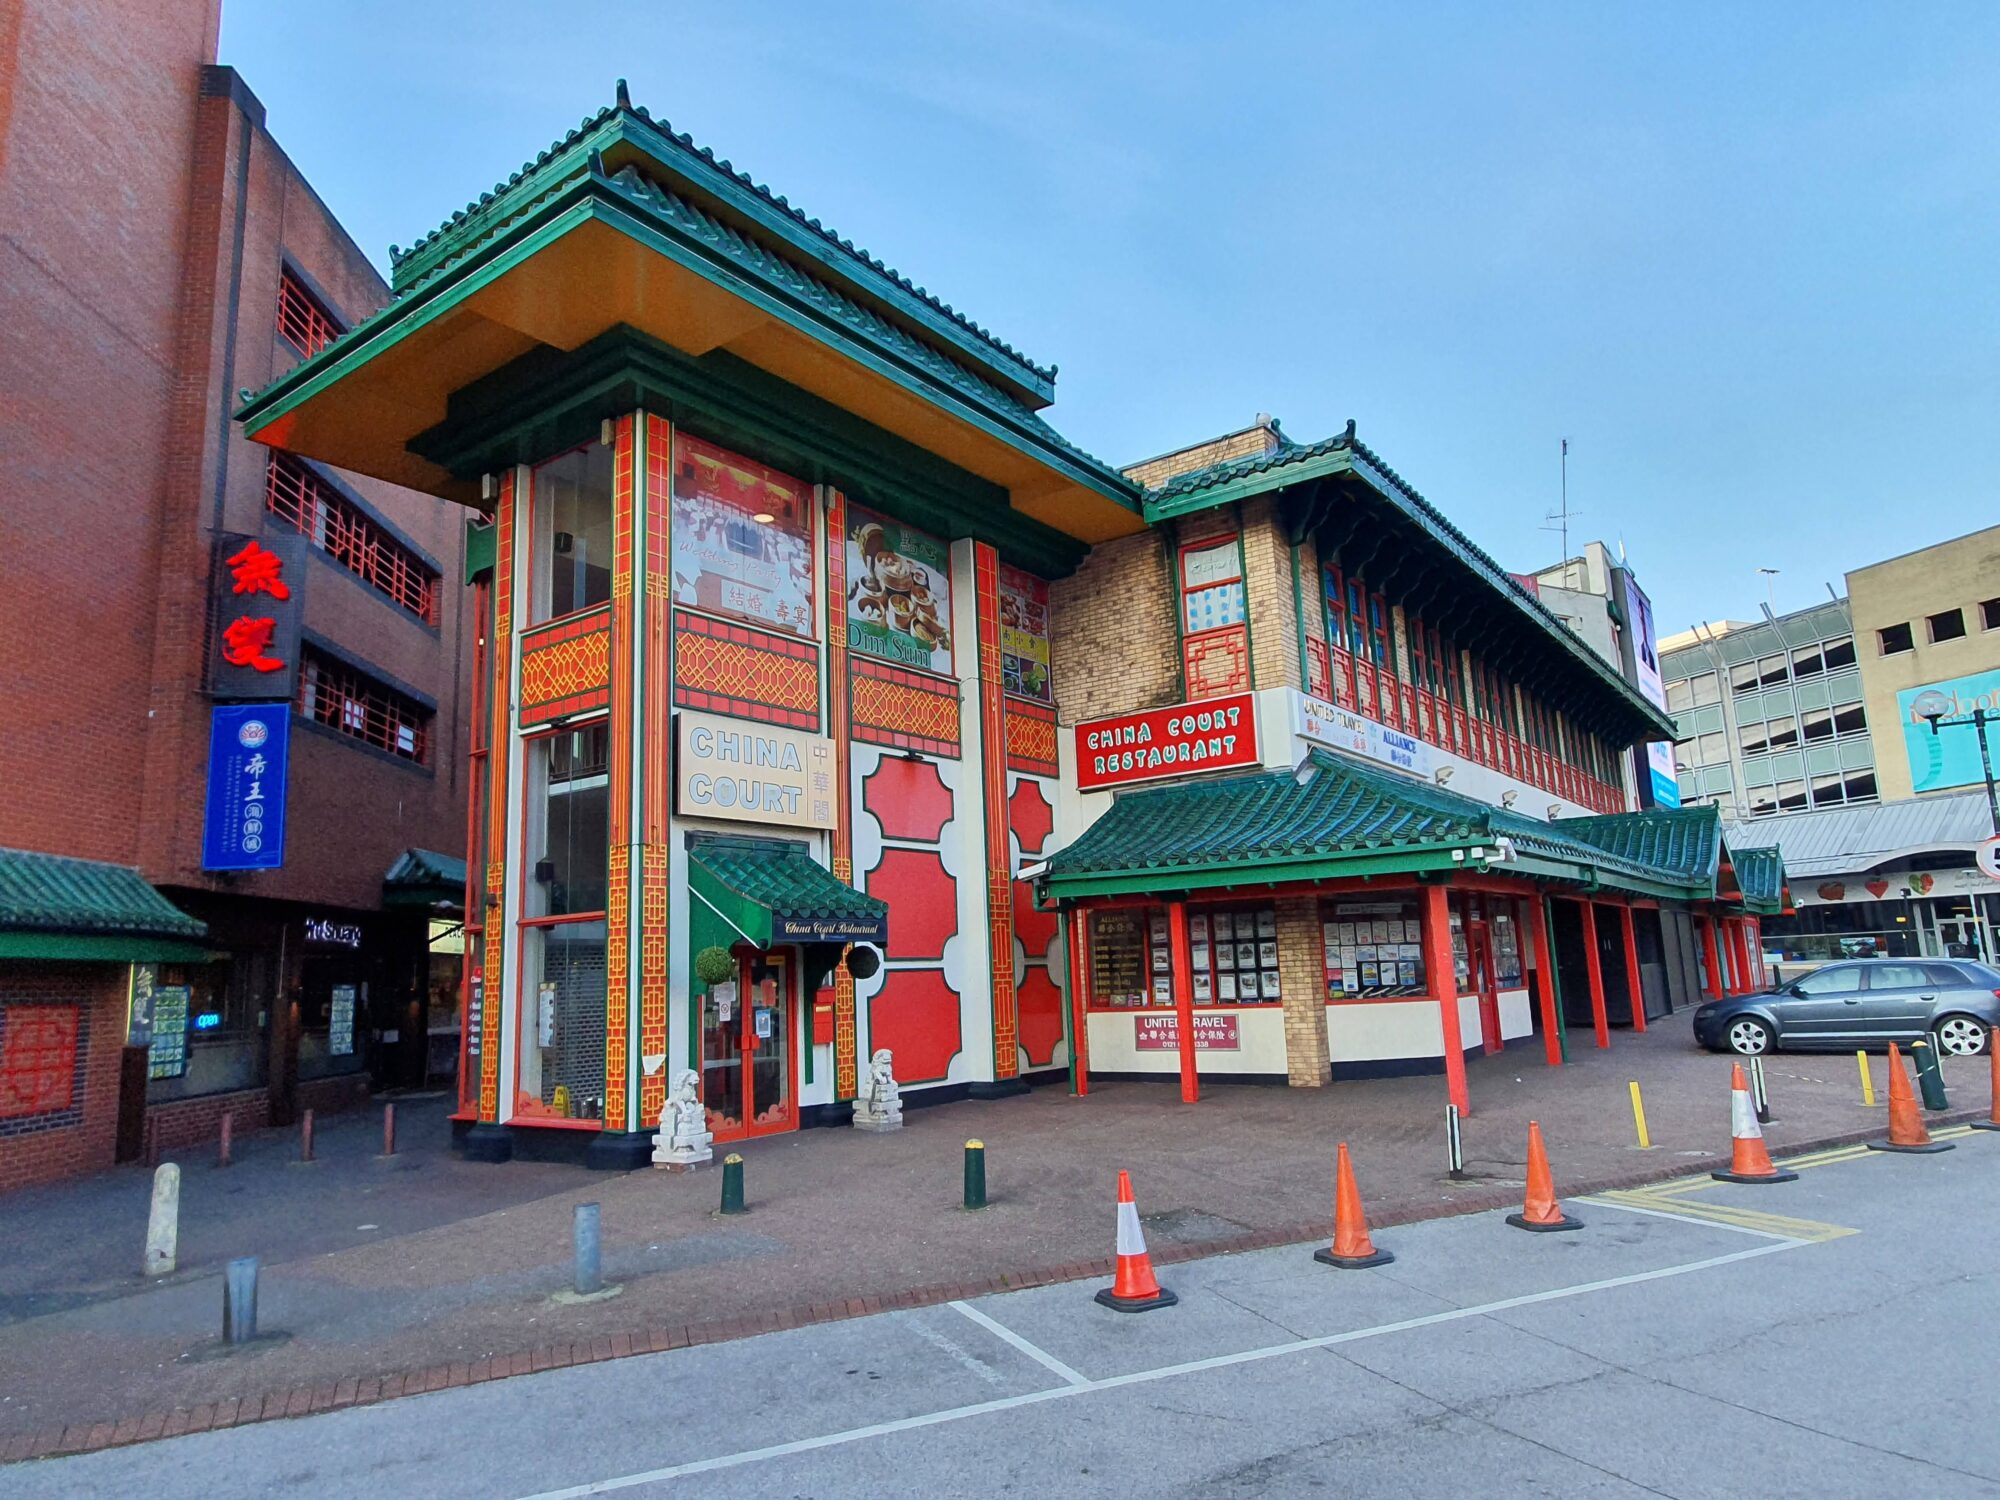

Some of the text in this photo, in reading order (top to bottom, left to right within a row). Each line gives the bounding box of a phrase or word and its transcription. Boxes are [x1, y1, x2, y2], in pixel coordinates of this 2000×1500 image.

[680, 542, 782, 587] Wedding Party
[848, 623, 929, 667] Dim Sum
[1088, 707, 1241, 750] CHINA COURT
[1303, 698, 1365, 735] UNITED TRAVEL
[690, 726, 802, 772] CHINA
[1094, 735, 1237, 775] RESTAURANT
[688, 772, 803, 815] COURT
[785, 921, 878, 934] China Court Restaurant
[1193, 1017, 1227, 1028] RAVEL
